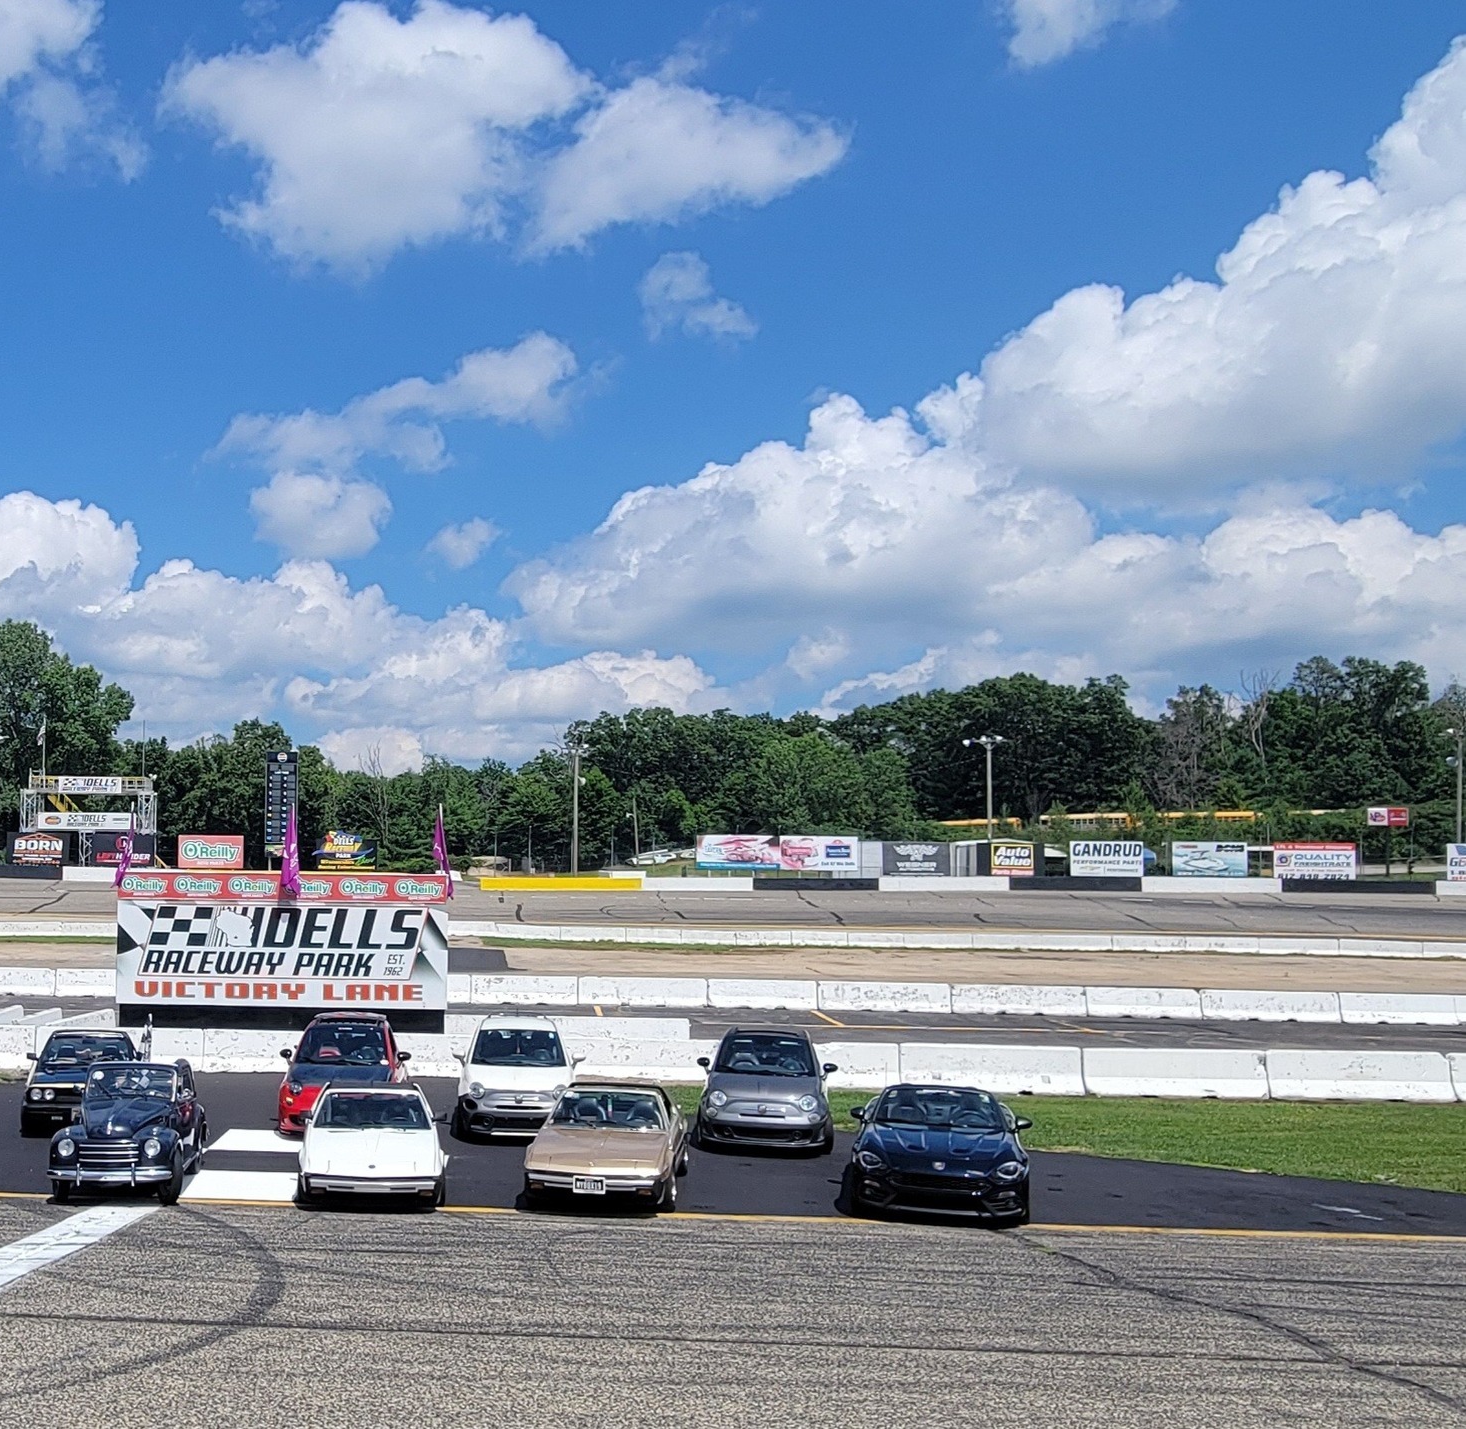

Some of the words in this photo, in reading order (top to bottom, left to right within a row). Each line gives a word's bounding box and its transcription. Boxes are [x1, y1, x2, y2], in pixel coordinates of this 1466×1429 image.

[14, 839, 63, 851] BORN
[183, 841, 238, 861] O'Reilly
[995, 846, 1030, 857] Auto
[1072, 843, 1142, 857] GANDRUD
[993, 856, 1031, 866] Value
[1294, 853, 1353, 861] QUALITY
[122, 877, 166, 892] O'Reilly
[176, 877, 220, 893] O'Reilly
[229, 878, 274, 893] O'Reilly
[300, 881, 330, 895] Reilly
[341, 879, 385, 894] O'Reilly
[396, 880, 441, 895] O'Reilly
[142, 949, 285, 976] RACEWAY
[292, 951, 375, 977] PARK
[387, 953, 405, 965] EST.
[383, 966, 403, 976] 1962
[134, 980, 306, 1000] VICTORY
[322, 983, 424, 1002] LANE
